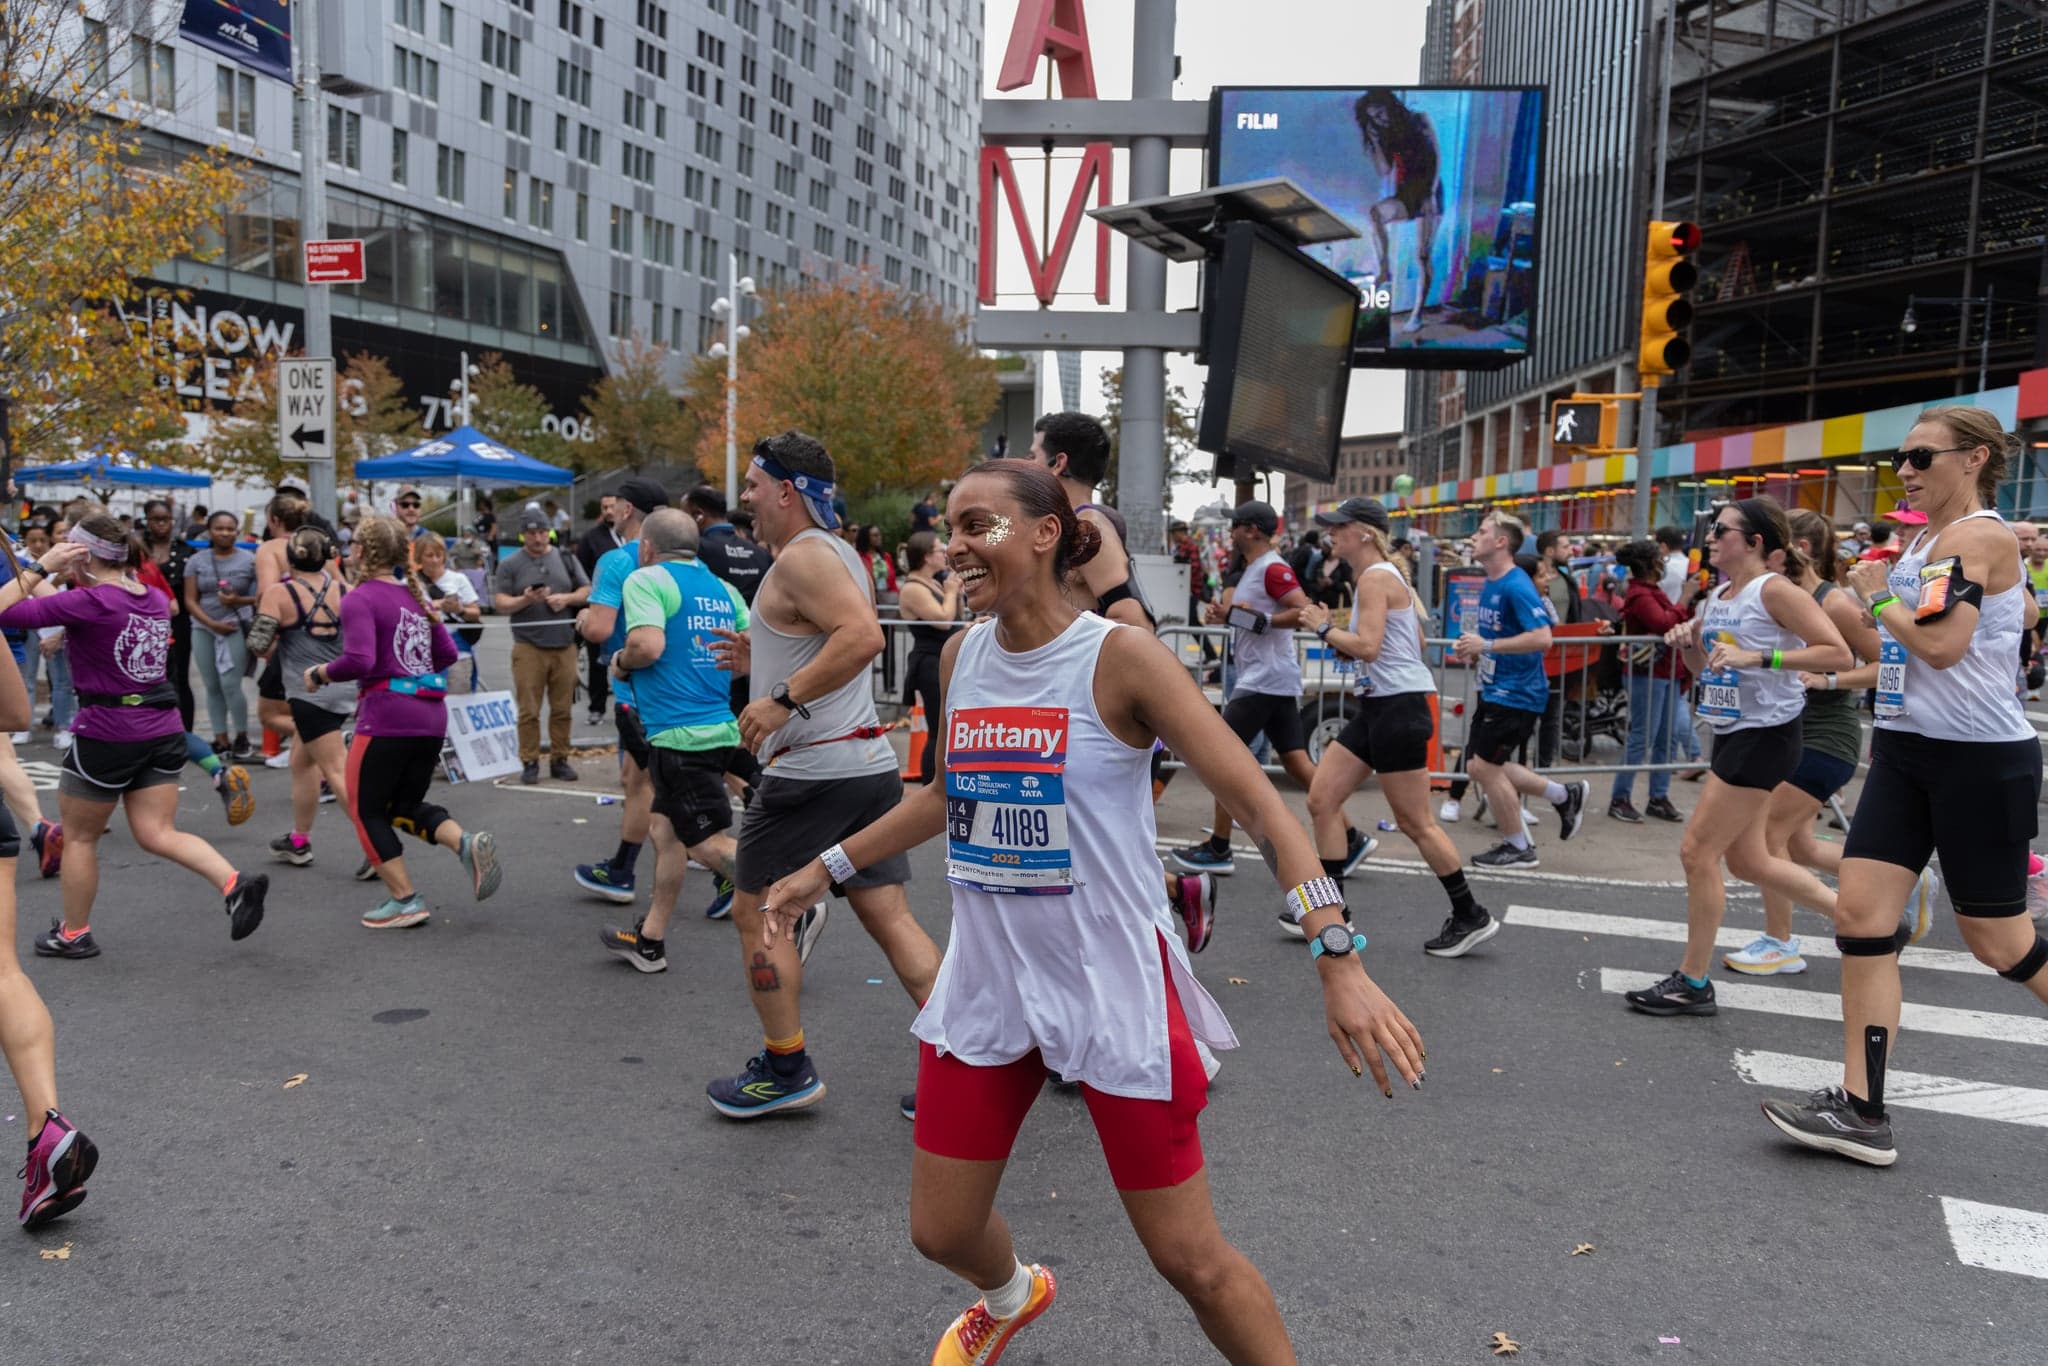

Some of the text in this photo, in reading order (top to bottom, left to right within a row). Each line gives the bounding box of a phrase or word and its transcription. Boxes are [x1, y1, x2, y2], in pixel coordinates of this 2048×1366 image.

[1237, 112, 1278, 130] FILM
[171, 301, 296, 358] NOW
[288, 367, 324, 390] ONE
[287, 394, 325, 417] WAY
[693, 596, 733, 614] TEAM
[687, 615, 736, 632] IRELAN
[953, 719, 1063, 758] Brittany
[956, 772, 977, 792] tcs
[1020, 789, 1043, 798] TATA
[958, 802, 968, 816] 4
[992, 807, 1050, 848] 41189
[960, 825, 968, 837] B
[991, 852, 1021, 865] 2022
